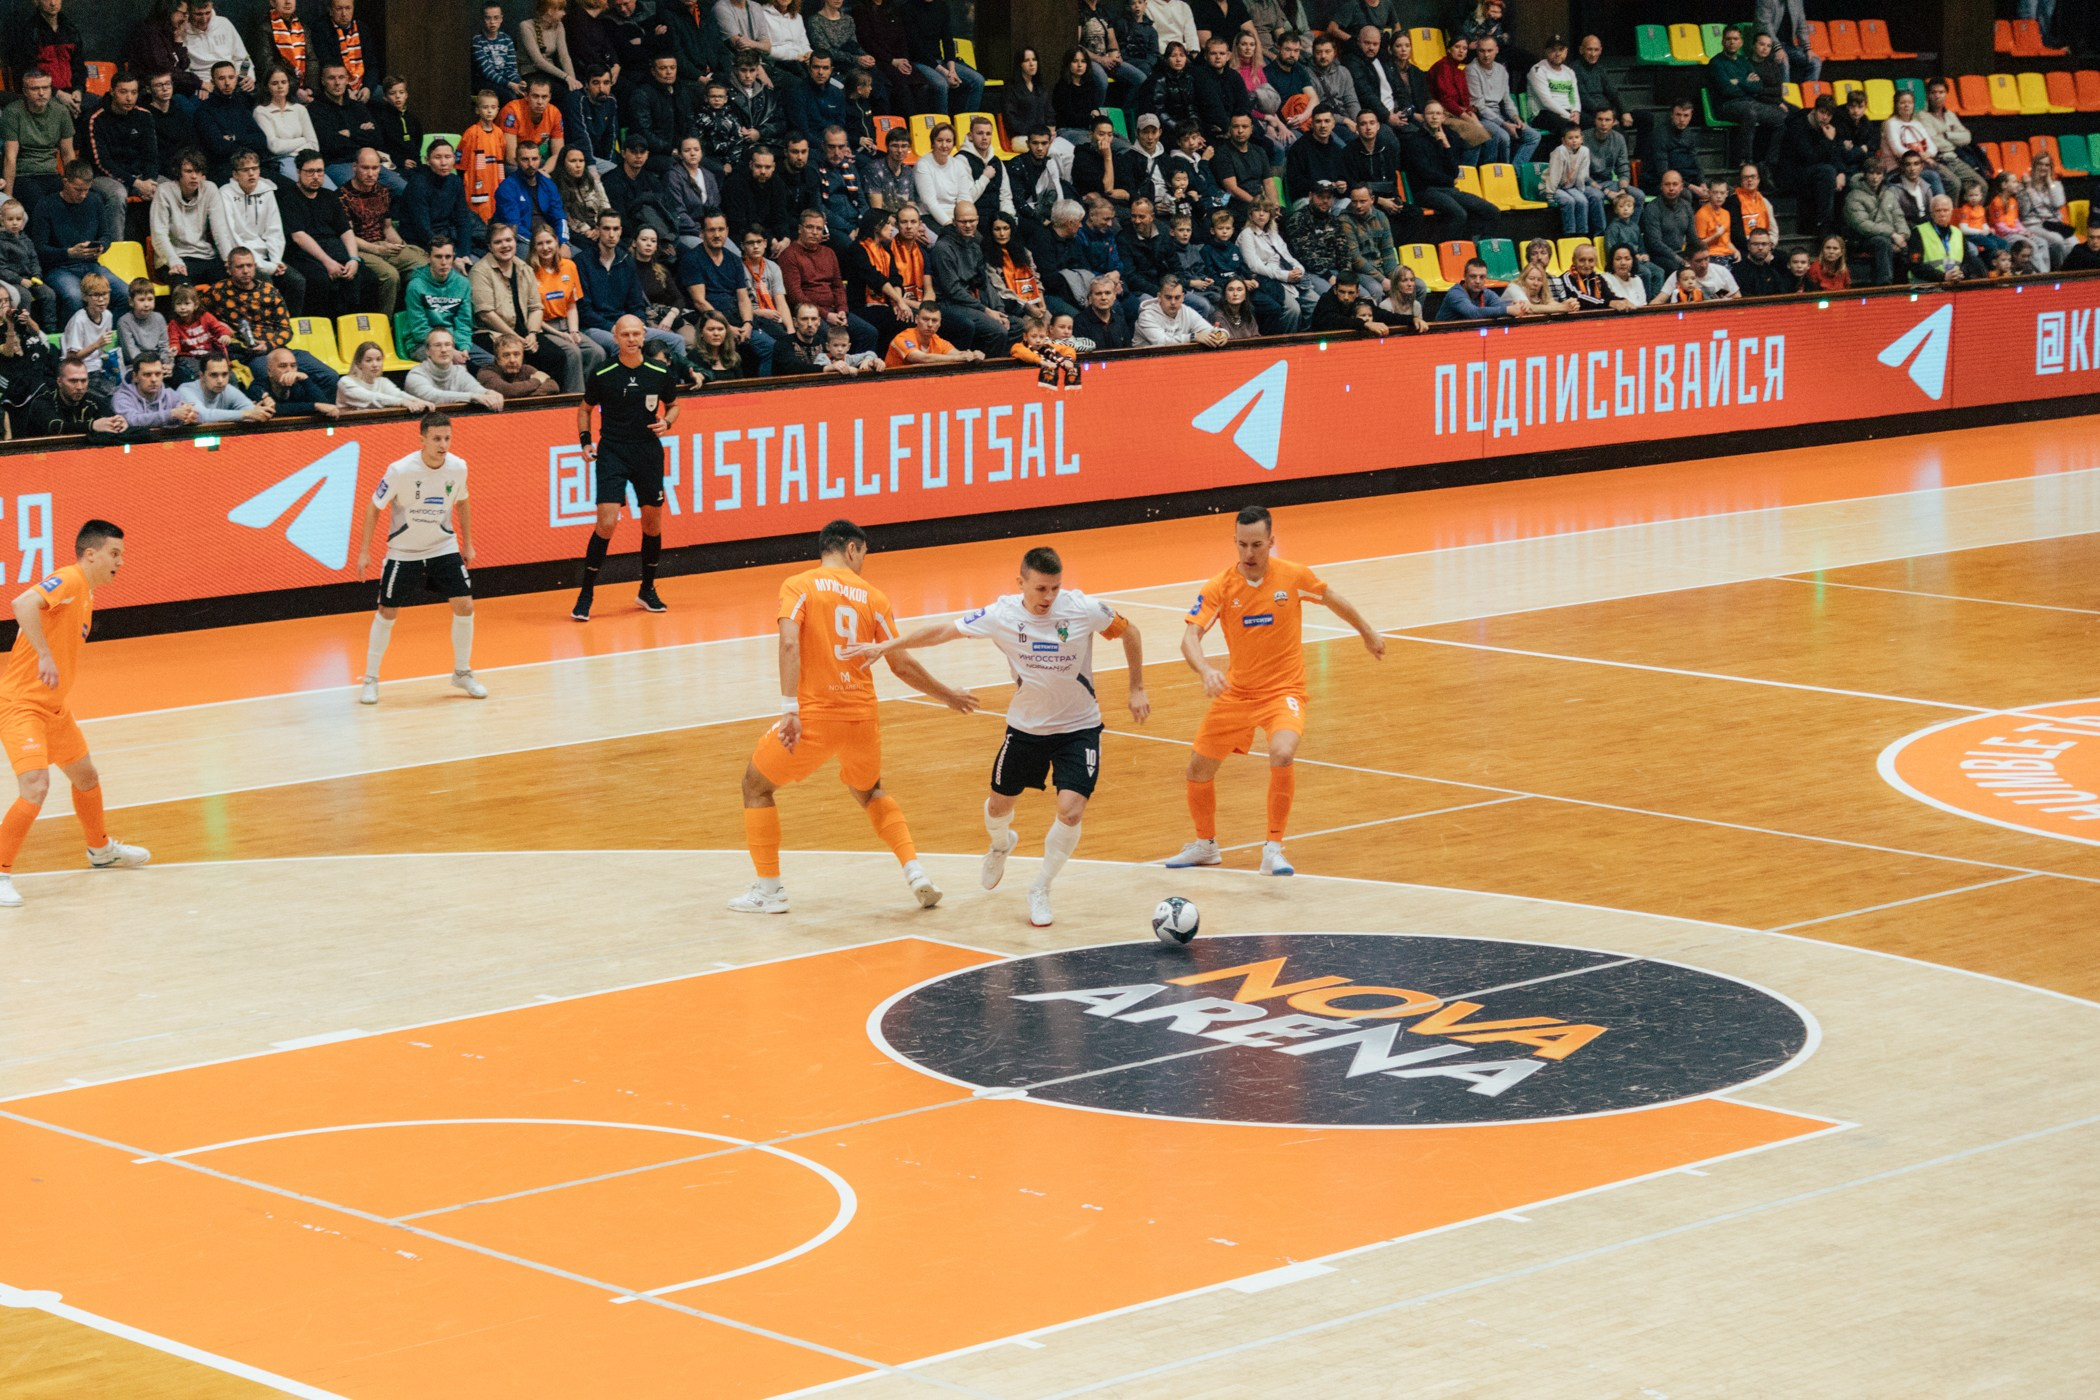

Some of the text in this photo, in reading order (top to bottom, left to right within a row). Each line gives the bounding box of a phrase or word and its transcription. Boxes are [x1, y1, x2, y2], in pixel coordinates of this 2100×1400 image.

[1435, 329, 1785, 438] ПОДПИСЫВАЙСЯ
[2036, 307, 2100, 376] @K
[0, 492, 54, 586] Я
[834, 604, 858, 661] 9
[1019, 653, 1077, 663] ИНГОССТРАХ
[1085, 748, 1097, 766] 10
[1959, 736, 2100, 821] HUMBLE
[1008, 983, 1548, 1097] ARENA
[1165, 956, 1609, 1061] NOVA
